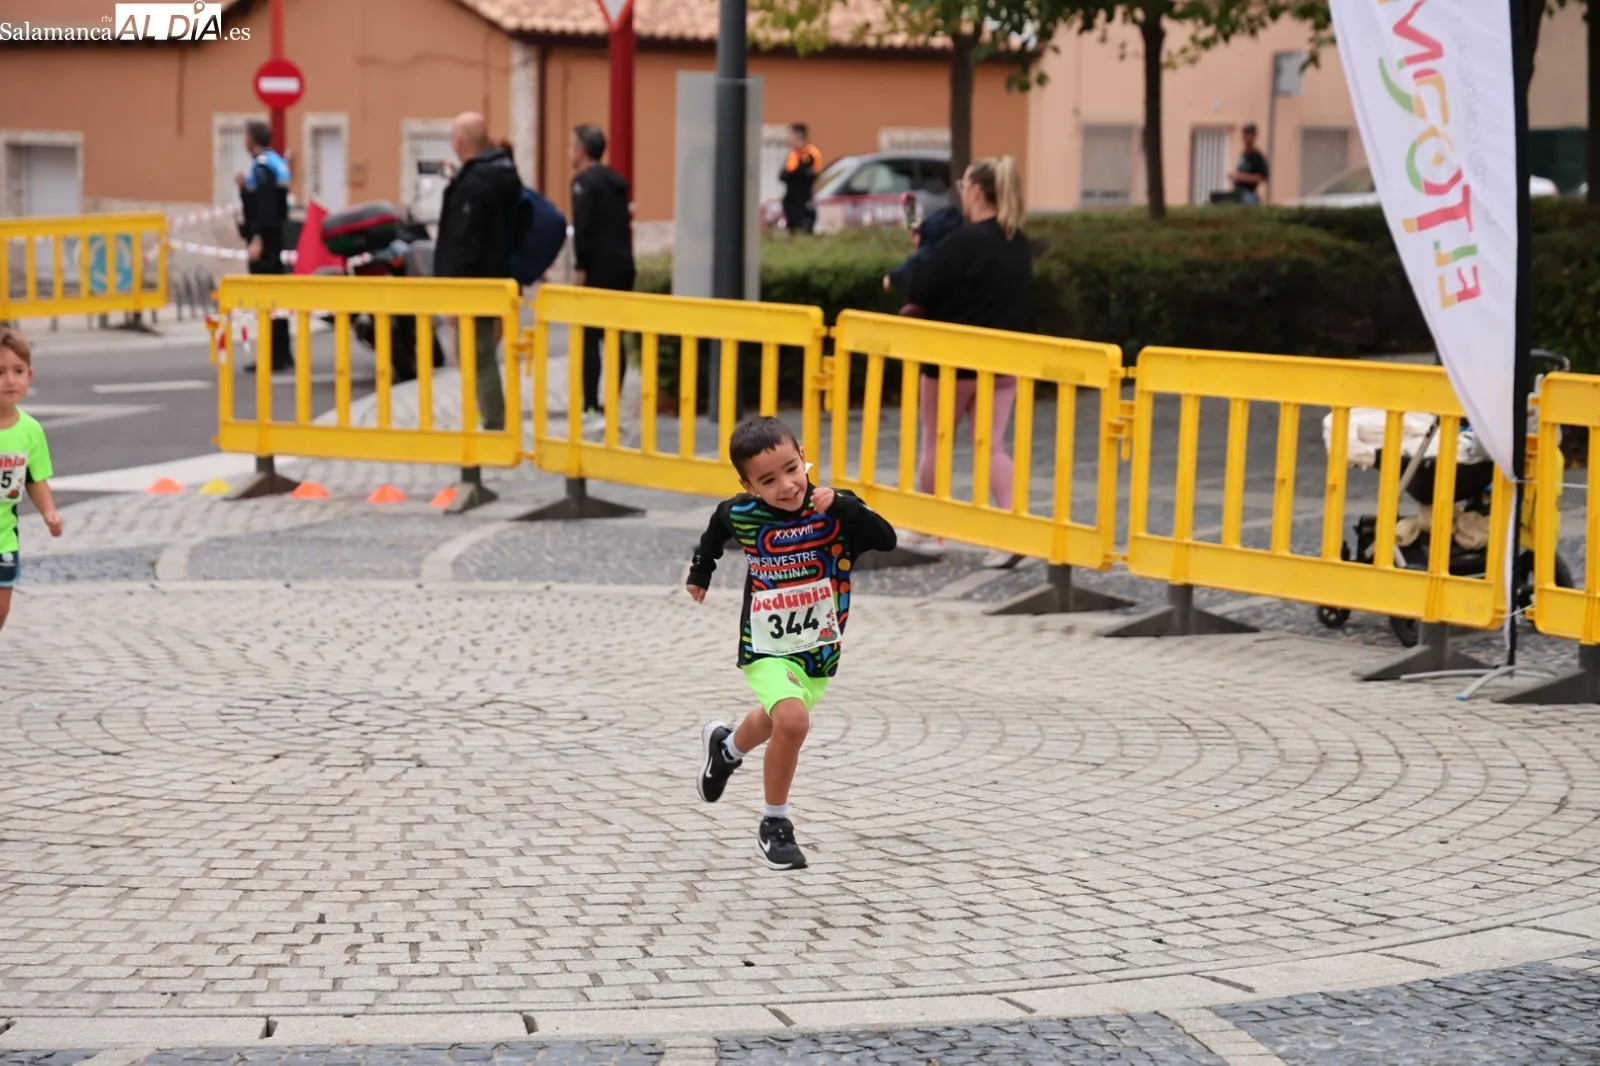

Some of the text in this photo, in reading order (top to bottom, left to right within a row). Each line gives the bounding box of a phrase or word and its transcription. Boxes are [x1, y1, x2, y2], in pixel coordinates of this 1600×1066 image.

[774, 524, 814, 540] XXXVIII
[760, 550, 818, 567] SILVESTRE
[750, 566, 809, 580] SMANTINA
[752, 586, 832, 612] bedunia
[768, 606, 820, 640] 344
